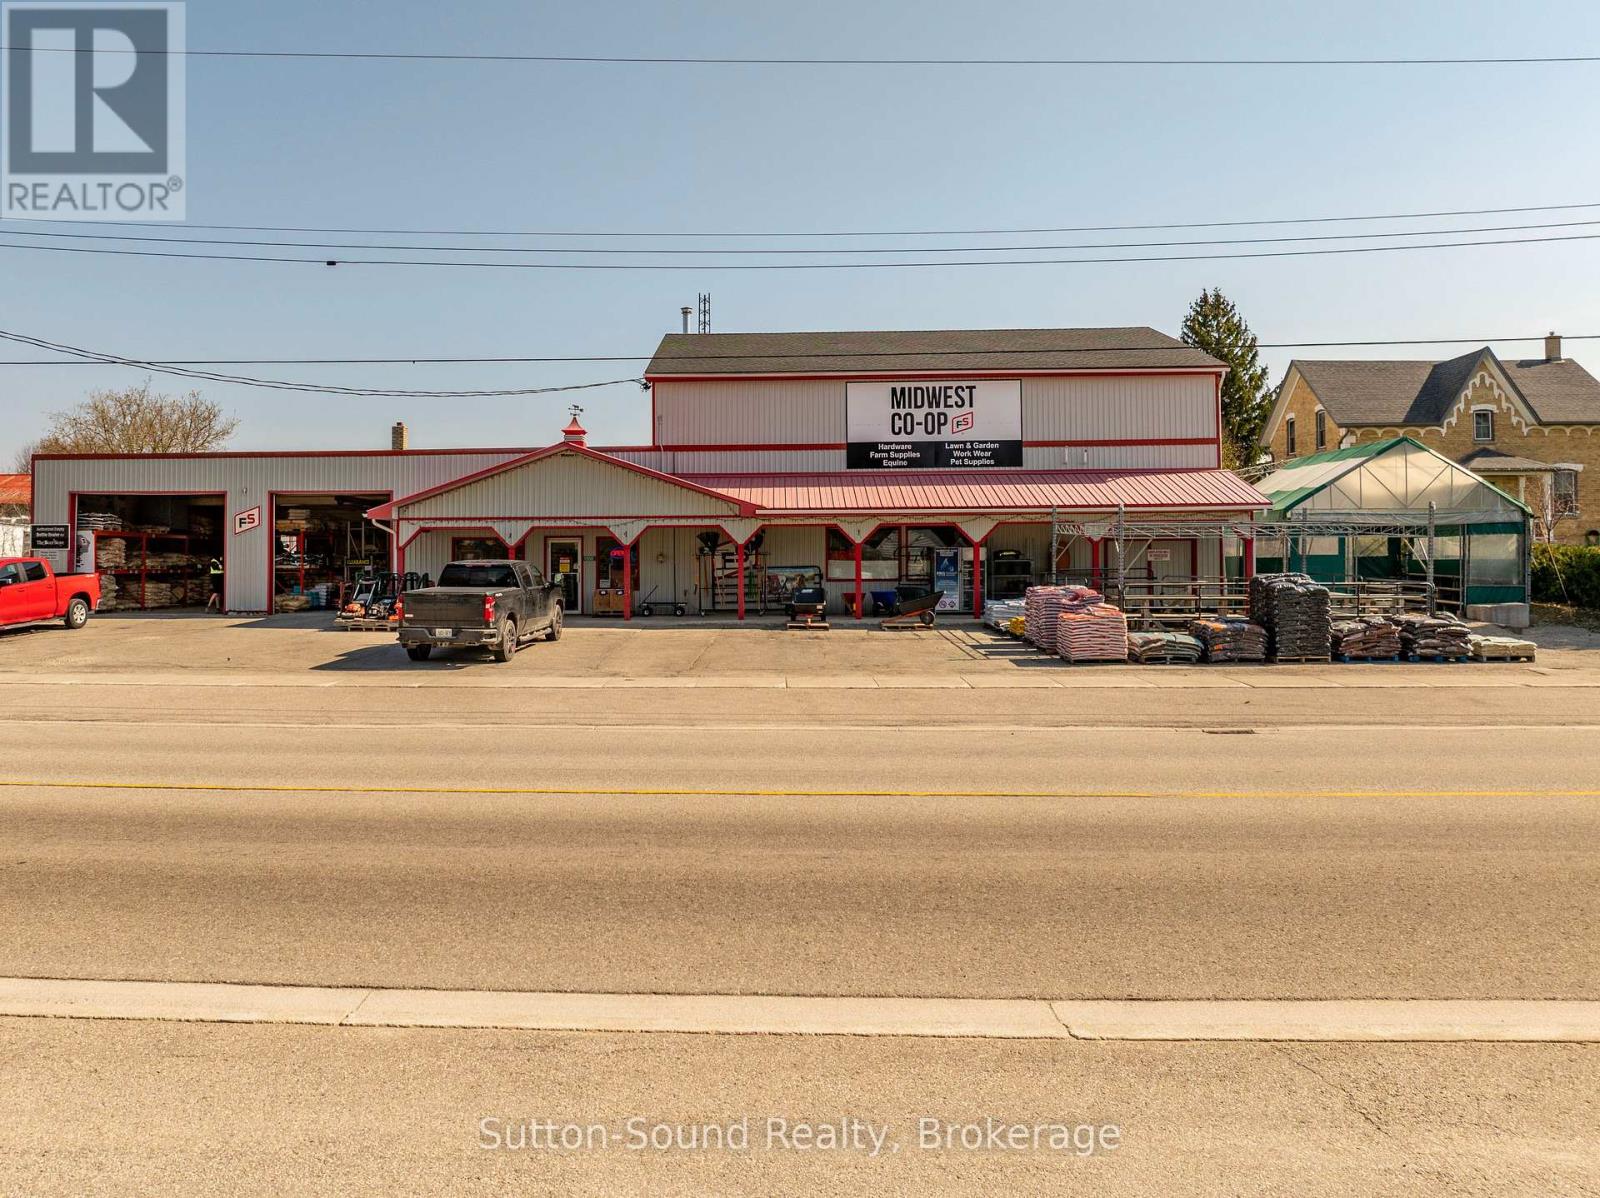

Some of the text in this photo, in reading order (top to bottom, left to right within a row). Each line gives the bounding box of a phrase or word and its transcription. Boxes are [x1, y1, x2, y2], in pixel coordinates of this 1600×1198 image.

[891, 385, 976, 409] MIDWEST
[891, 412, 948, 435] CO-OP
[956, 417, 969, 429] FS
[889, 451, 921, 459] Supplies
[883, 459, 908, 467] Equine
[963, 458, 995, 466] Supplies
[239, 513, 255, 528] FS
